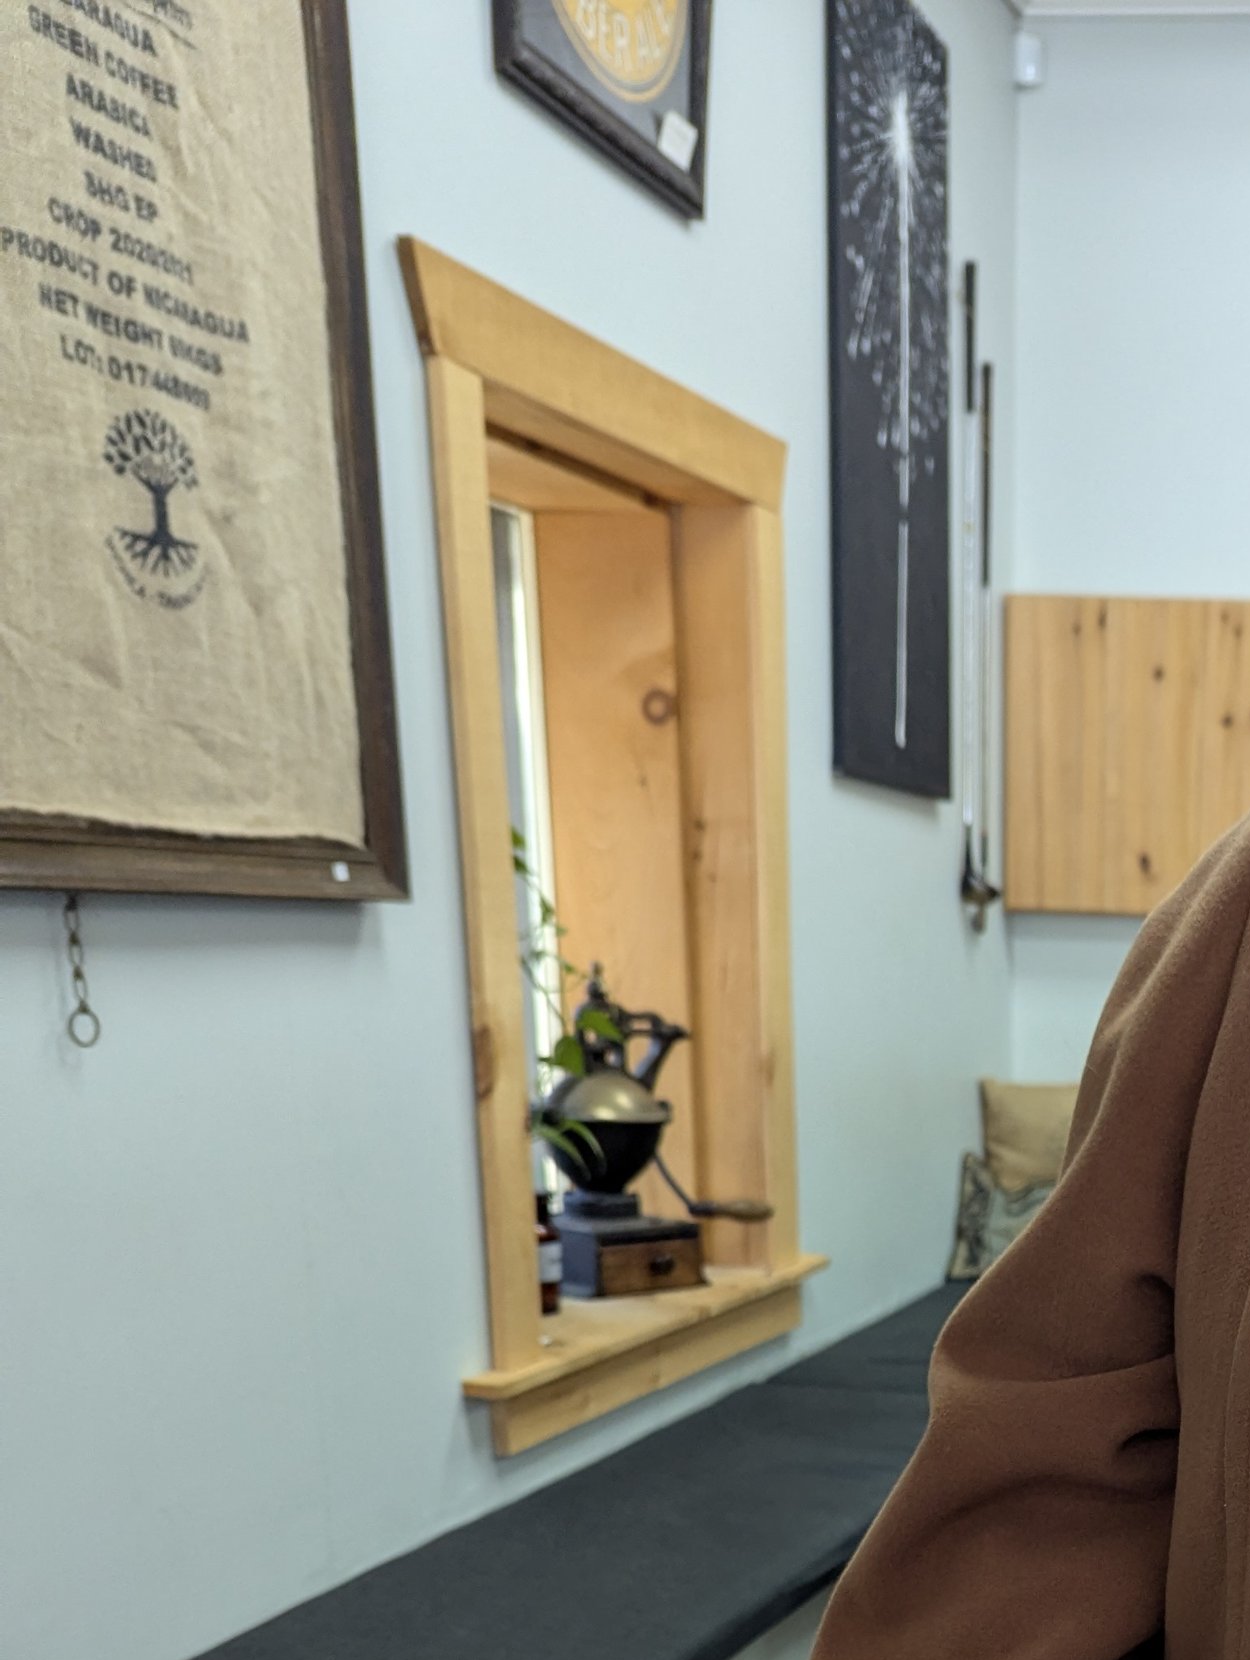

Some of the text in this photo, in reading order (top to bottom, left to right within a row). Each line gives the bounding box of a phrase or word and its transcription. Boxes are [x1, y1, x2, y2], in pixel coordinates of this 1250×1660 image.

[28, 4, 99, 66] GREEN
[105, 51, 179, 110] COFFEE
[66, 72, 152, 140] ARABICA
[48, 198, 101, 241] CROP
[0, 227, 98, 285] PRODUCT
[107, 271, 136, 298] OF
[39, 281, 78, 318] NET
[84, 302, 163, 350] WEIGHT
